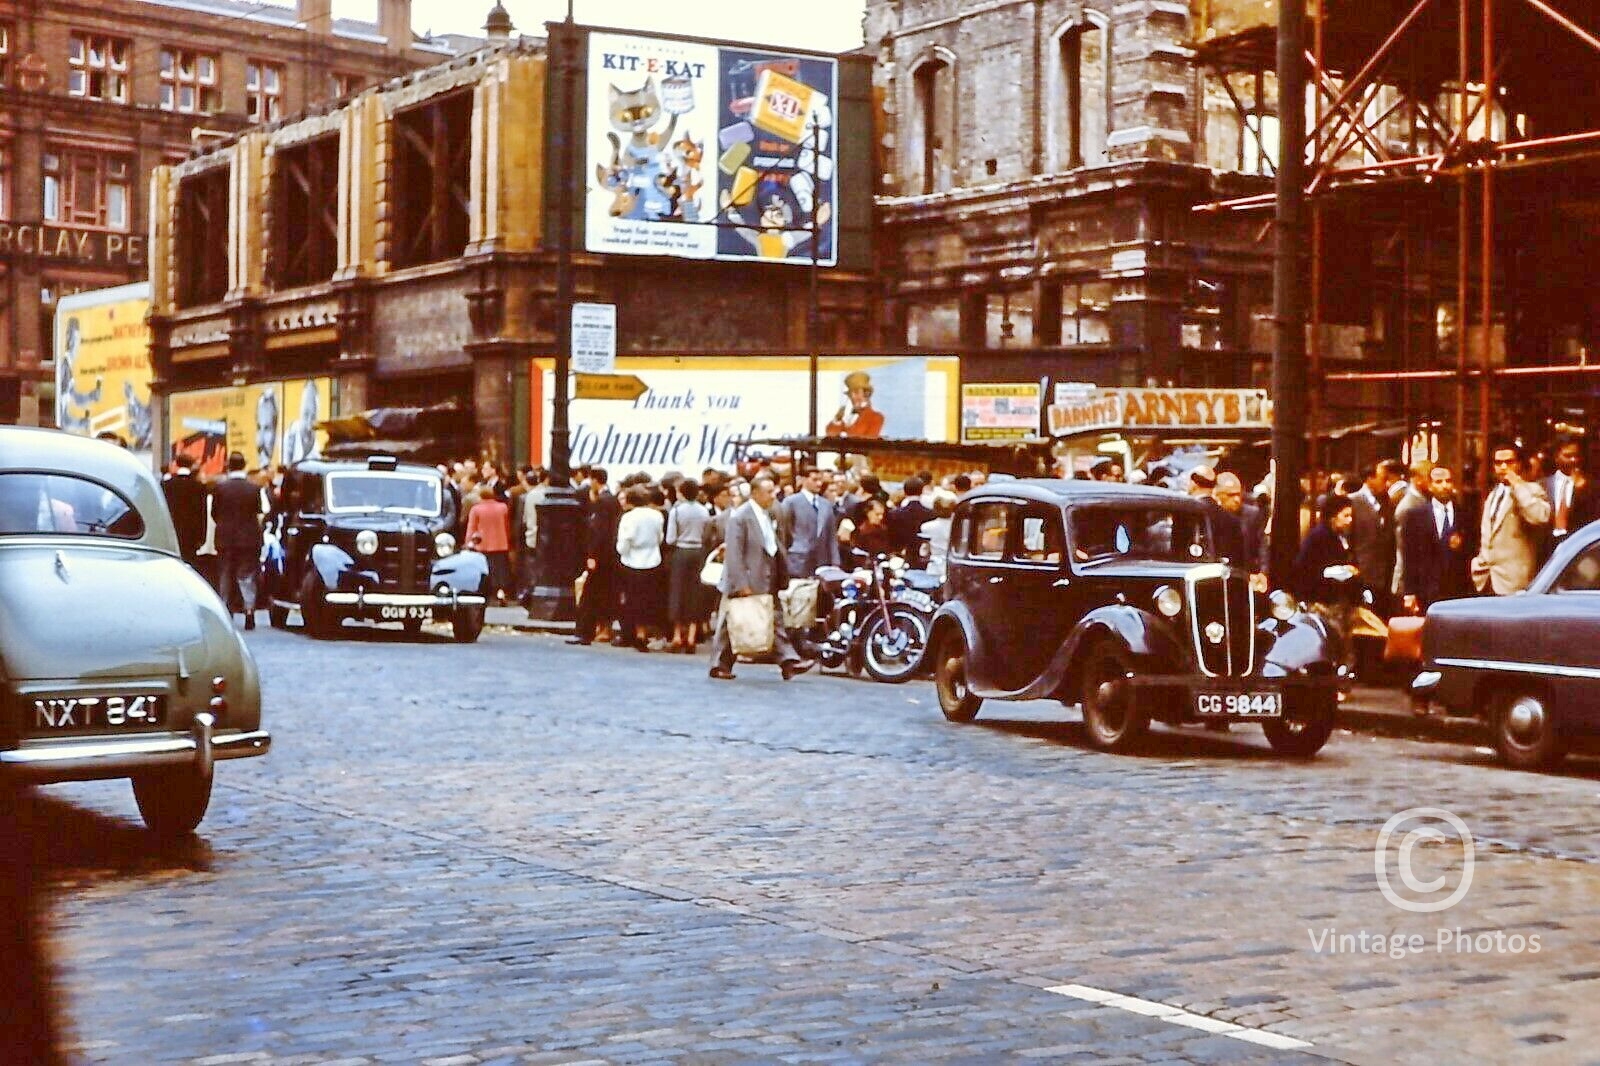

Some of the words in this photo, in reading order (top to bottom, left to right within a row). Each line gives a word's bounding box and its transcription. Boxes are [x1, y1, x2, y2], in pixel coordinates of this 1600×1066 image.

[652, 228, 667, 236] and
[107, 234, 143, 264] PE
[701, 395, 741, 415] you
[567, 423, 690, 465] Johnnie
[34, 698, 100, 727] NXT
[106, 695, 157, 725] 841
[1198, 695, 1221, 713] CG
[1225, 695, 1276, 714] 9844
